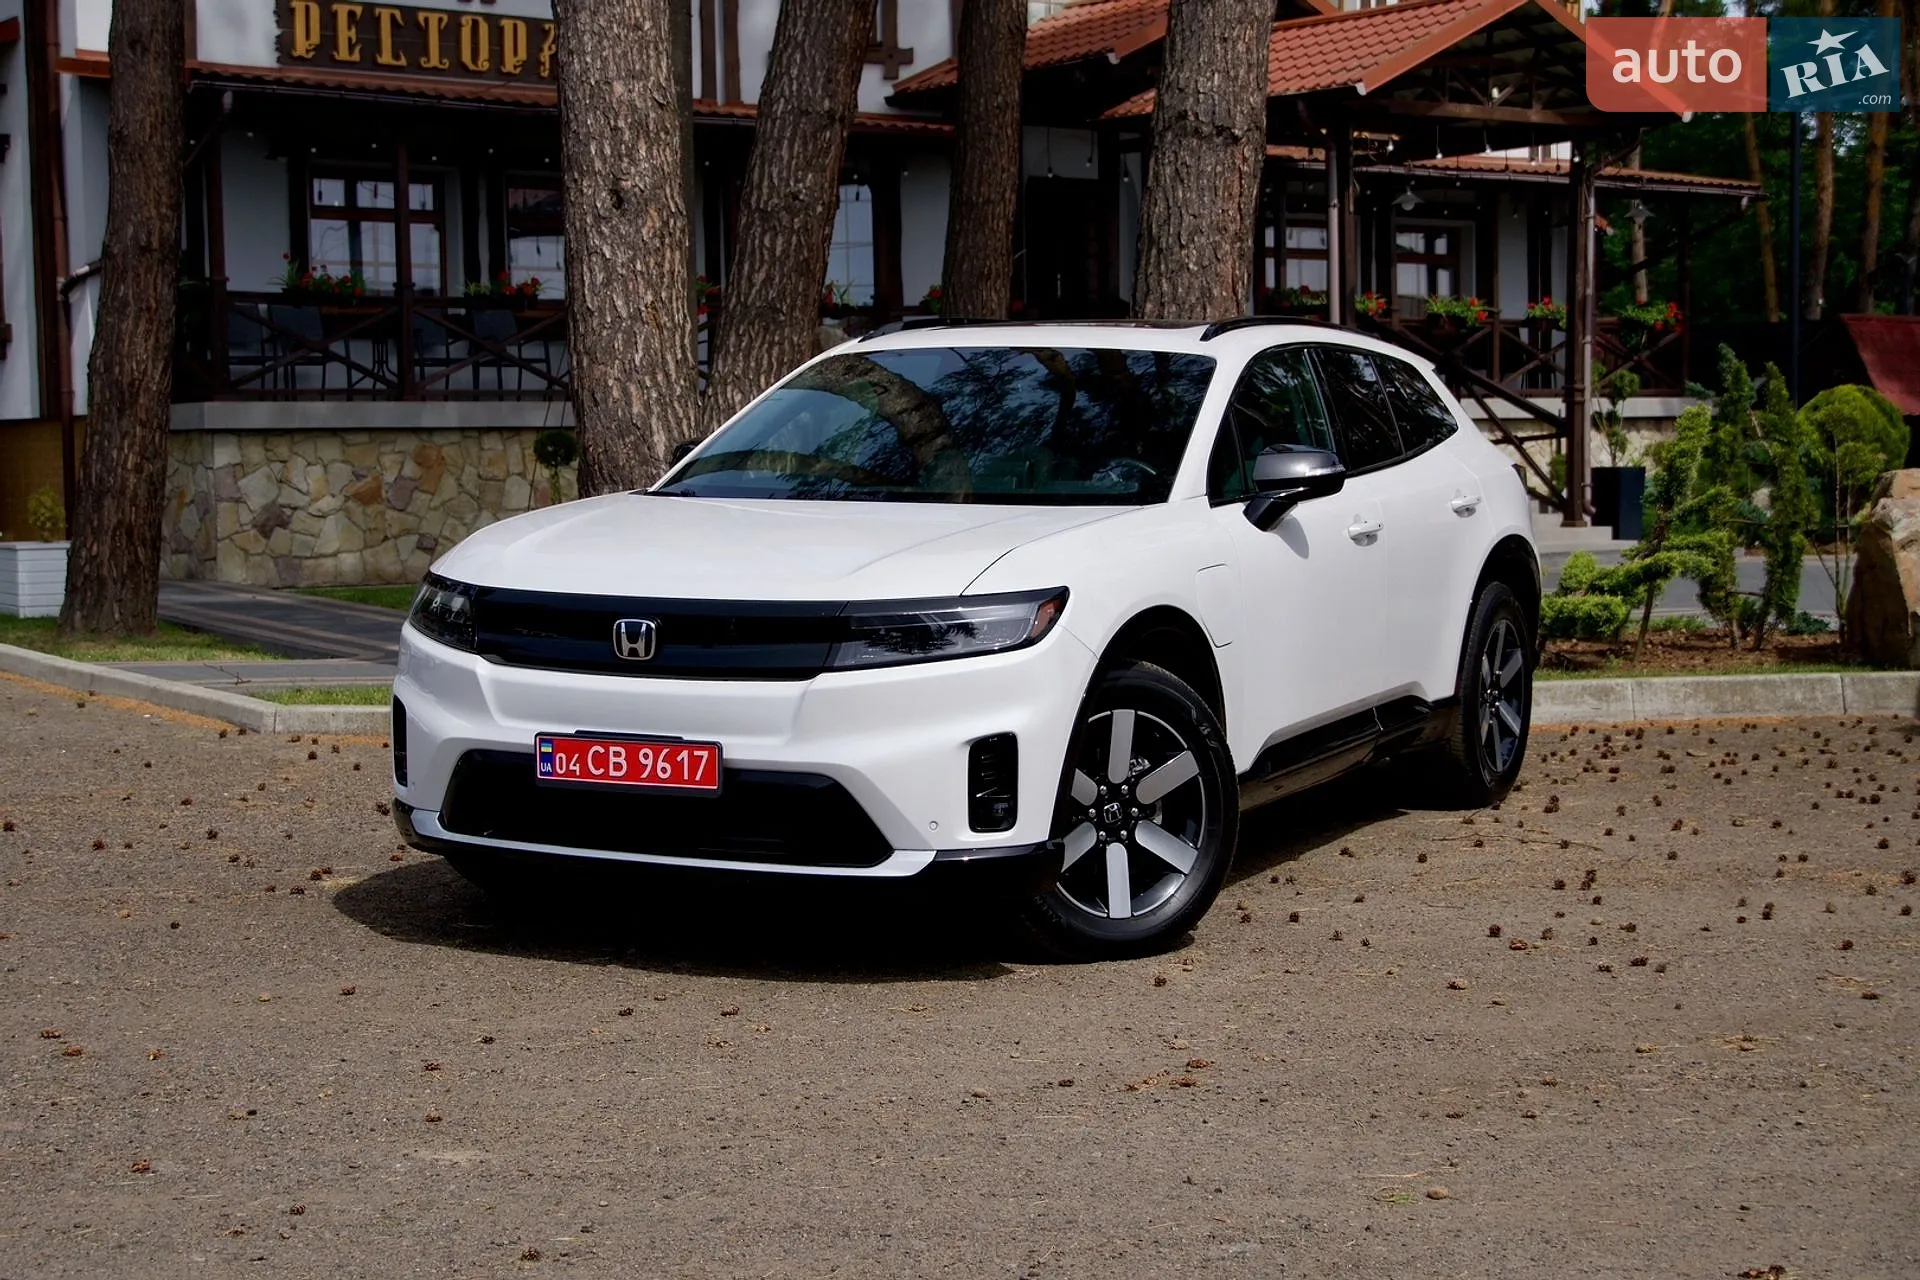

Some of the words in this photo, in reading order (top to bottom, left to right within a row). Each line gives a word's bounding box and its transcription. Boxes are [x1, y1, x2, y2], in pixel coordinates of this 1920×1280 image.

[540, 762, 553, 773] UA
[555, 752, 581, 776] 04
[587, 745, 628, 778] CB
[638, 747, 709, 781] 9617
